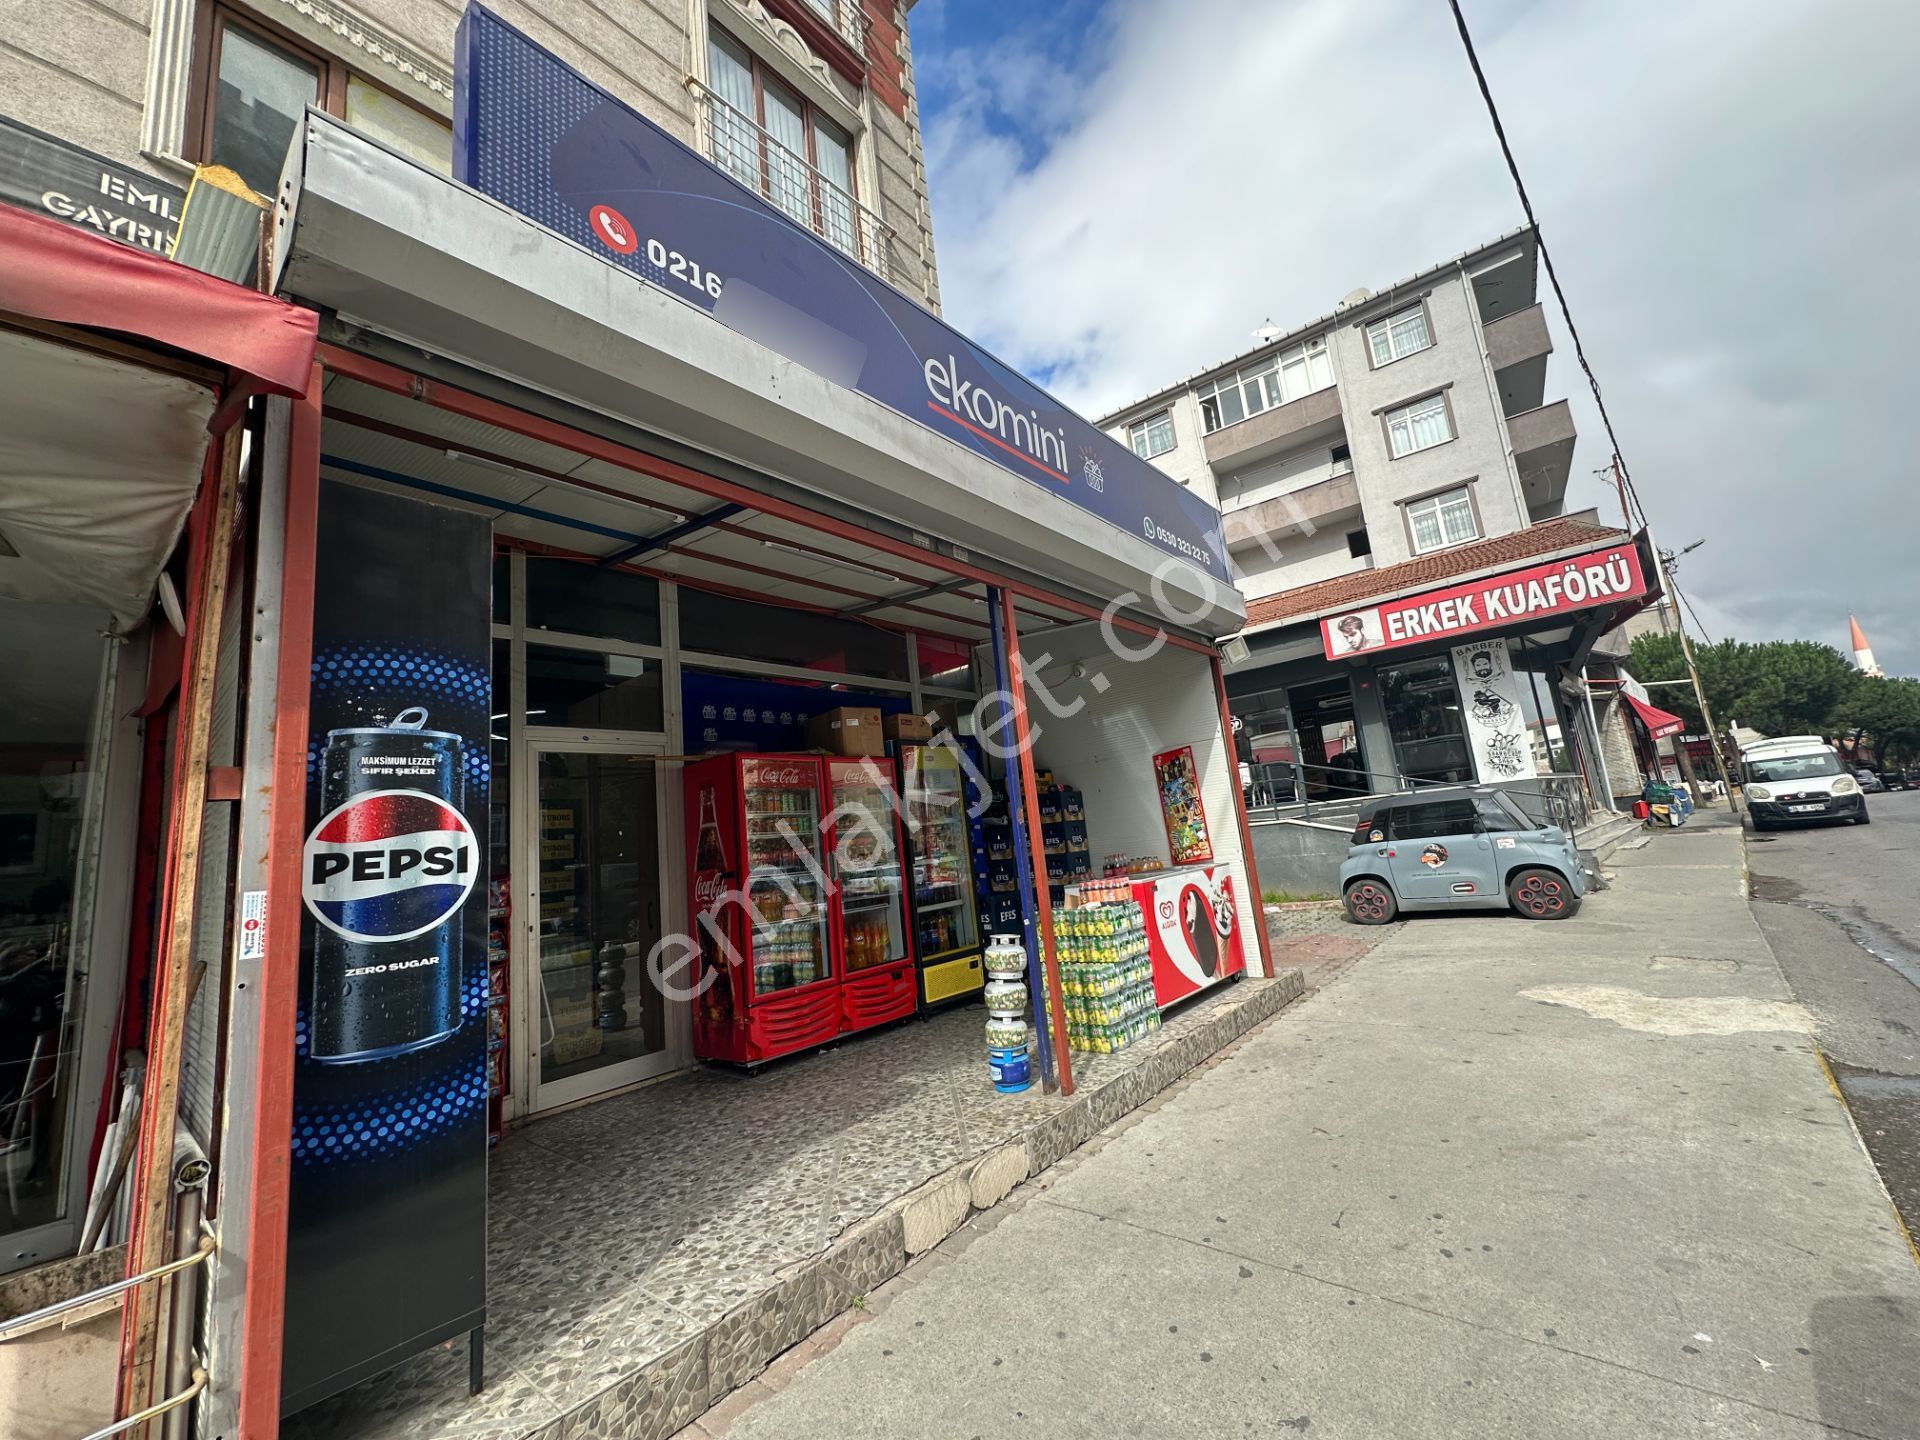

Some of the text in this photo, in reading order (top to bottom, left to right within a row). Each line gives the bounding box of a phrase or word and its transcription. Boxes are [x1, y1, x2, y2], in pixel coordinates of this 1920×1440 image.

[647, 238, 722, 299] 0216
[924, 355, 1069, 474] ekomini
[1156, 526, 1211, 565] 0530 323 22 75
[1386, 553, 1632, 642] ERKEK KUAFÖRÜ
[1456, 641, 1503, 657] BARBER
[361, 754, 436, 766] MAKSİMUM LEZZET
[361, 766, 436, 777] SIFIR ŞEKER
[312, 845, 469, 885] PEPSI
[1000, 909, 1017, 923] EFES
[344, 956, 440, 977] ZERO SUGAR
